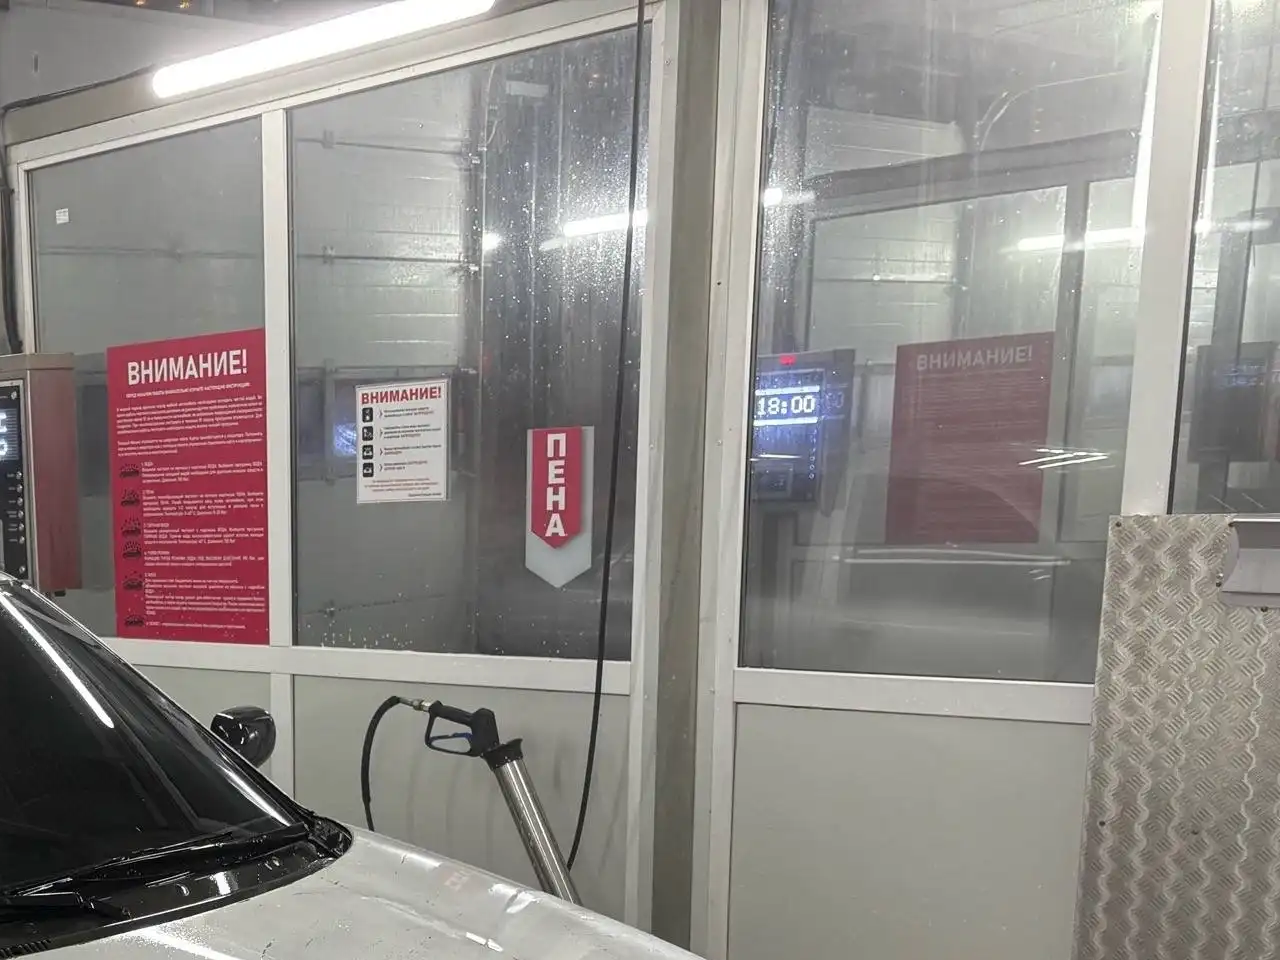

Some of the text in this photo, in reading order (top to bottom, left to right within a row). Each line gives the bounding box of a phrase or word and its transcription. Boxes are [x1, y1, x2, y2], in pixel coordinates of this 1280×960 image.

[127, 349, 248, 386] ВНИМАНИЕ!
[917, 345, 1033, 371] ВНИМАНИЕ!
[361, 386, 442, 405] ВНИМАНИЕ!
[757, 394, 816, 416] 18:00
[544, 432, 568, 538] ПЕНА
